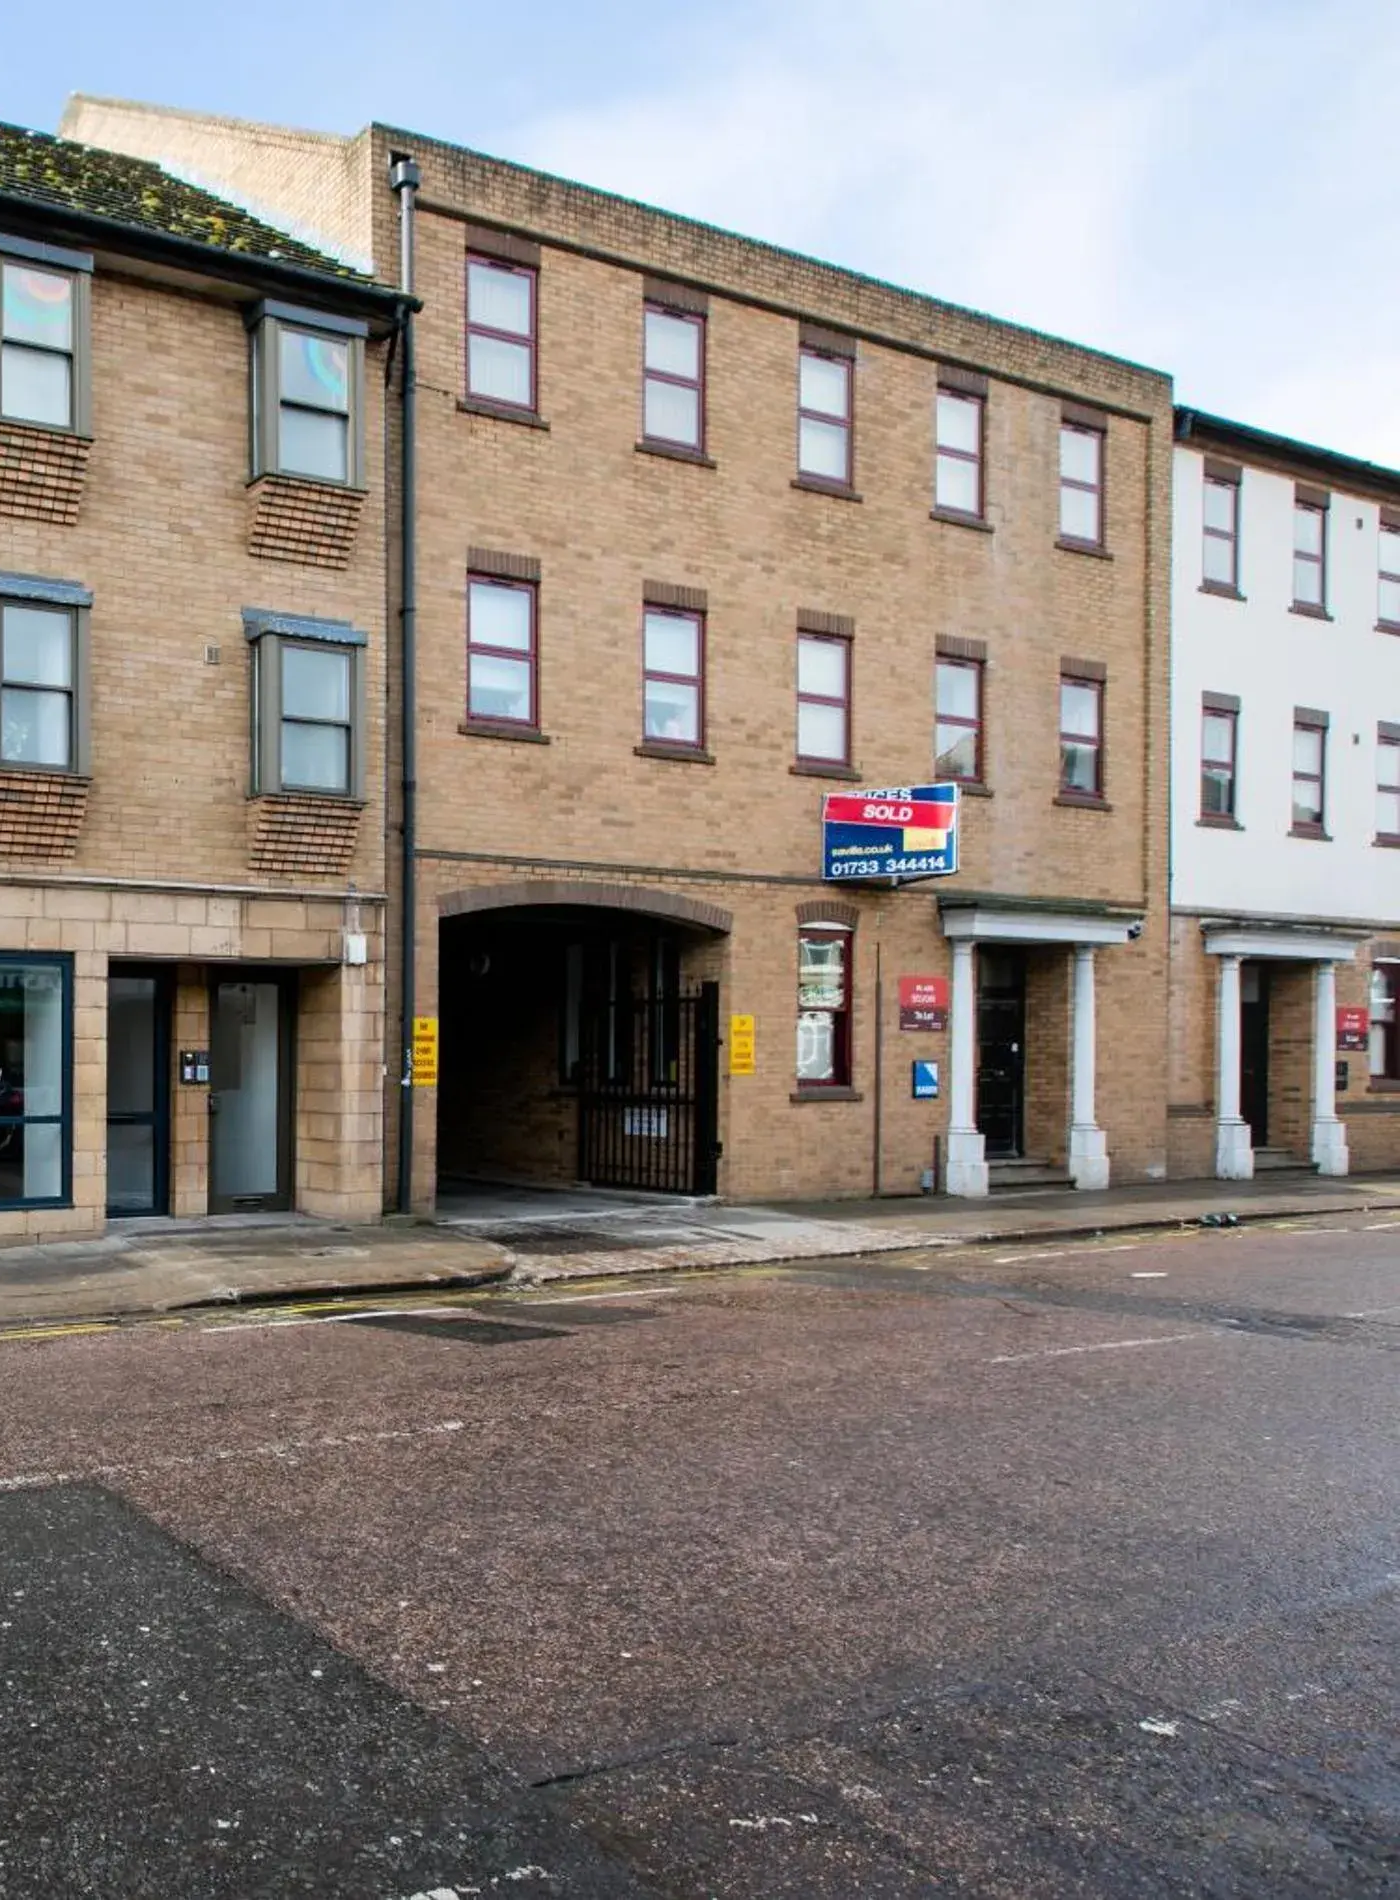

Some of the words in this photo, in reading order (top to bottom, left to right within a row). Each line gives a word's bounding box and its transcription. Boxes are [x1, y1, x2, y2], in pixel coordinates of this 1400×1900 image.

[863, 804, 913, 821] SOLD
[831, 860, 878, 875] 01733
[885, 855, 945, 872] 344414
